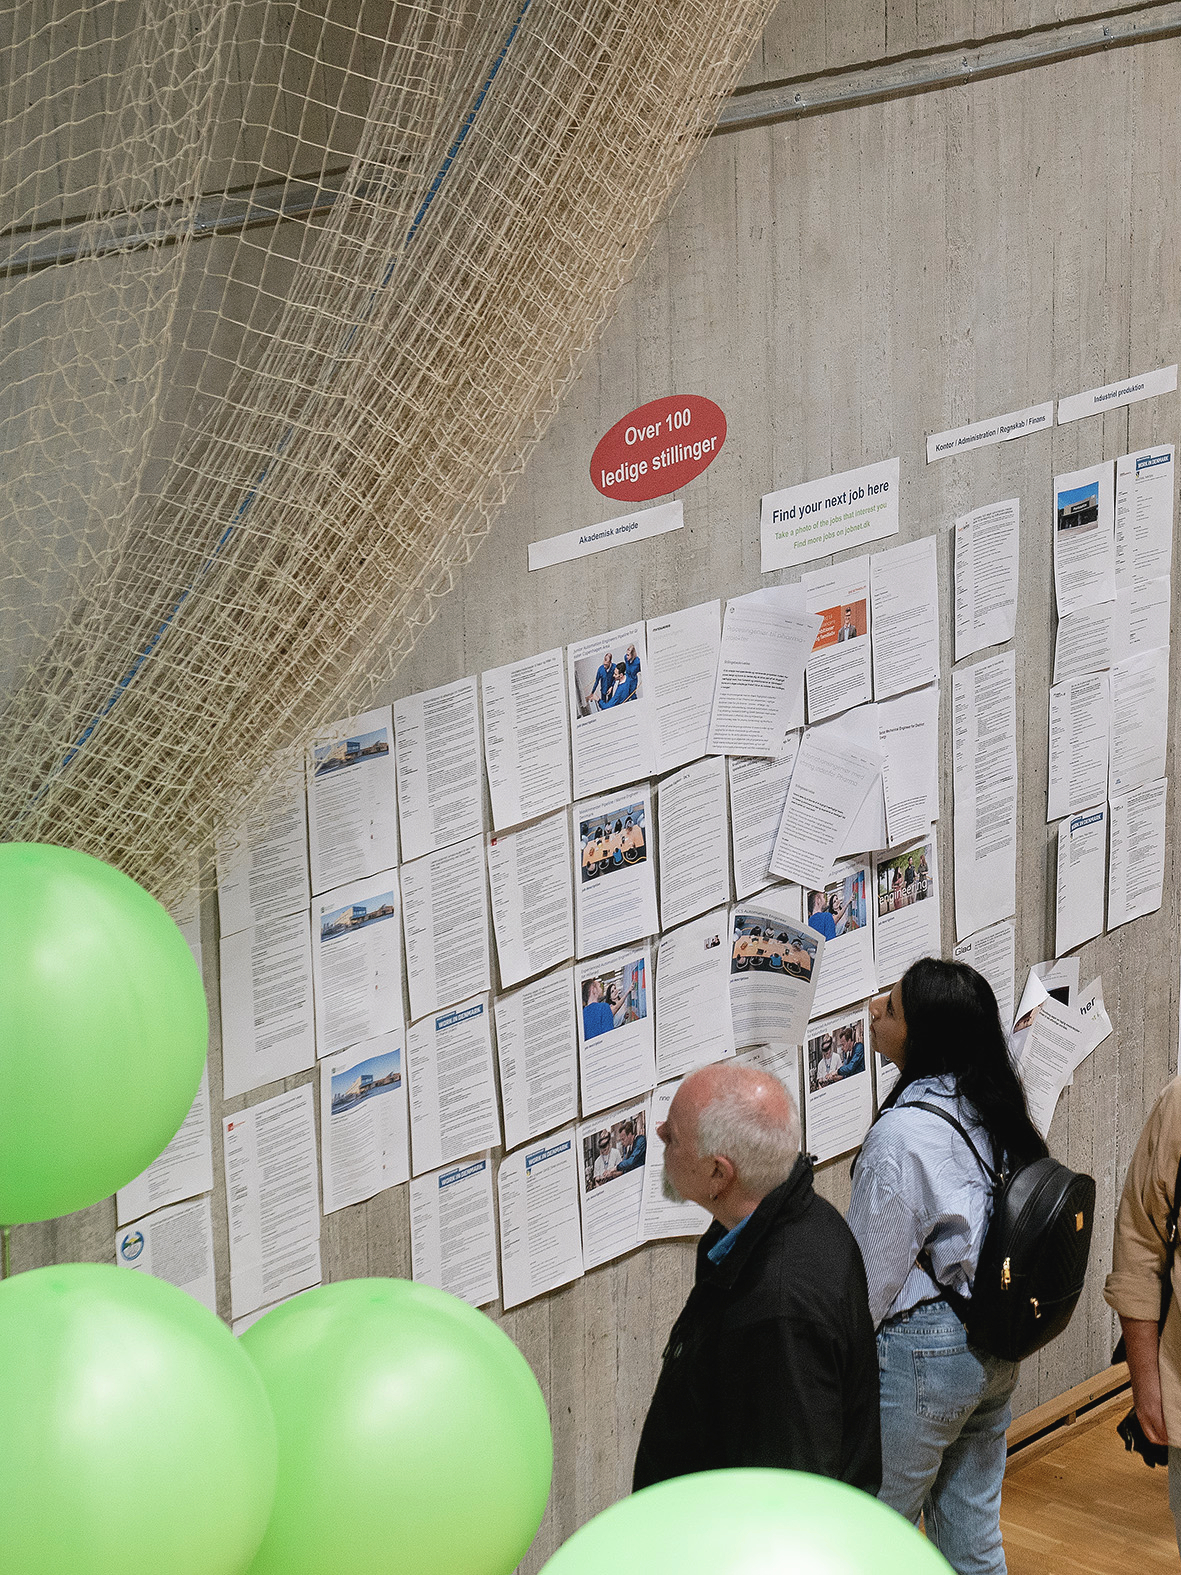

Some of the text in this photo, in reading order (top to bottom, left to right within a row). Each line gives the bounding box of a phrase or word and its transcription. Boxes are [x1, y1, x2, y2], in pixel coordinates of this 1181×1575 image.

[1094, 382, 1144, 402] Industriel produktion
[625, 408, 691, 445] Over 100
[935, 442, 954, 452] Kontor
[958, 429, 996, 446] Administration
[1000, 420, 1025, 434] Regnskab
[1029, 415, 1046, 424] Finans
[602, 436, 717, 488] ledige stillinger
[773, 482, 889, 523] Find your next job here
[579, 521, 638, 544] Akademisk arbejde
[775, 532, 788, 540] Take
[795, 524, 811, 535] photo
[830, 516, 842, 526] jobs
[843, 512, 854, 520] that
[855, 506, 875, 518] interest
[877, 502, 887, 512] you
[794, 539, 806, 549] Find
[823, 532, 835, 542] jobs
[845, 521, 870, 534] jobnet.dk
[880, 880, 928, 905] engineering
[1080, 996, 1096, 1016] her
